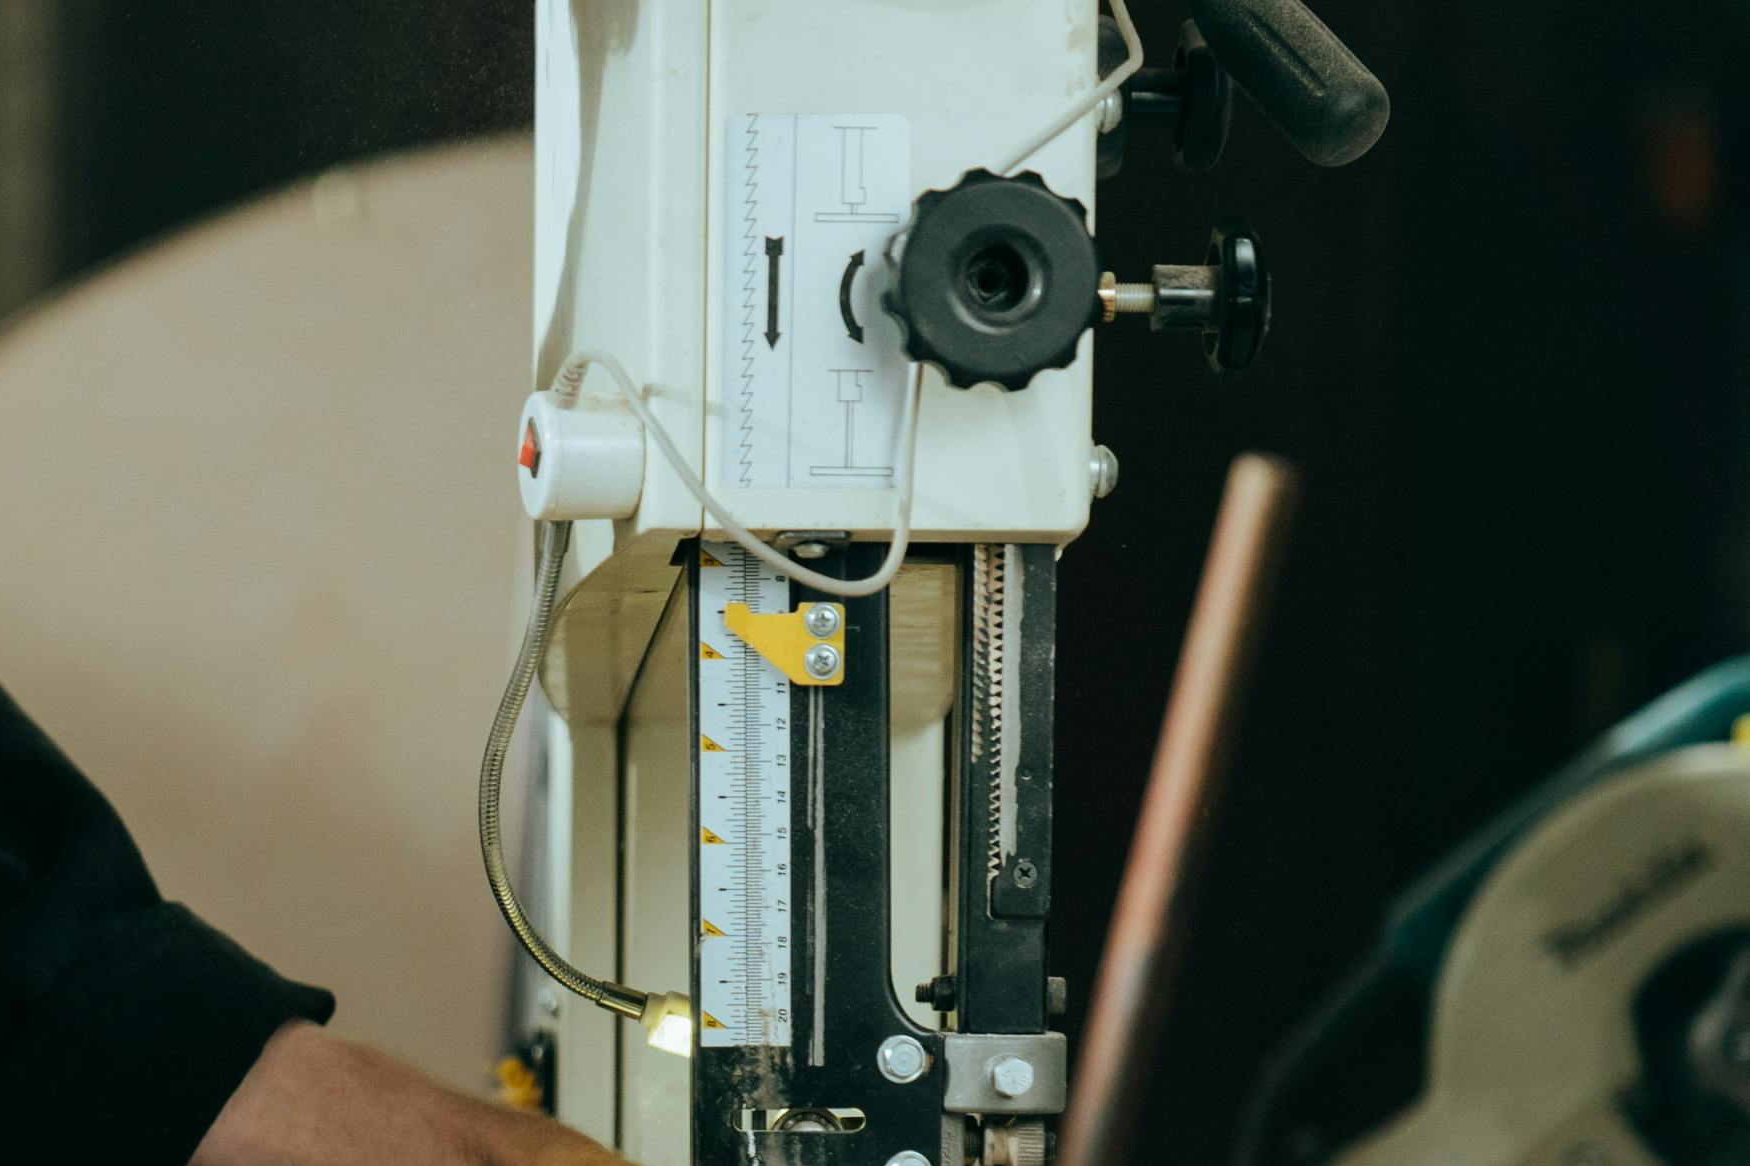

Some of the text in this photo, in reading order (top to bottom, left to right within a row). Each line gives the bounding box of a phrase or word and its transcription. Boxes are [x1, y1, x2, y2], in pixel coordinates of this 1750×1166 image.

[776, 682, 786, 694] 11
[776, 718, 786, 730] 12
[777, 754, 786, 767] 13
[777, 790, 786, 804] 14
[778, 826, 787, 840] 15
[778, 864, 787, 876] 16
[778, 900, 787, 912] 17
[778, 936, 788, 949] 18
[778, 972, 788, 985] 19
[778, 1008, 788, 1023] 20
